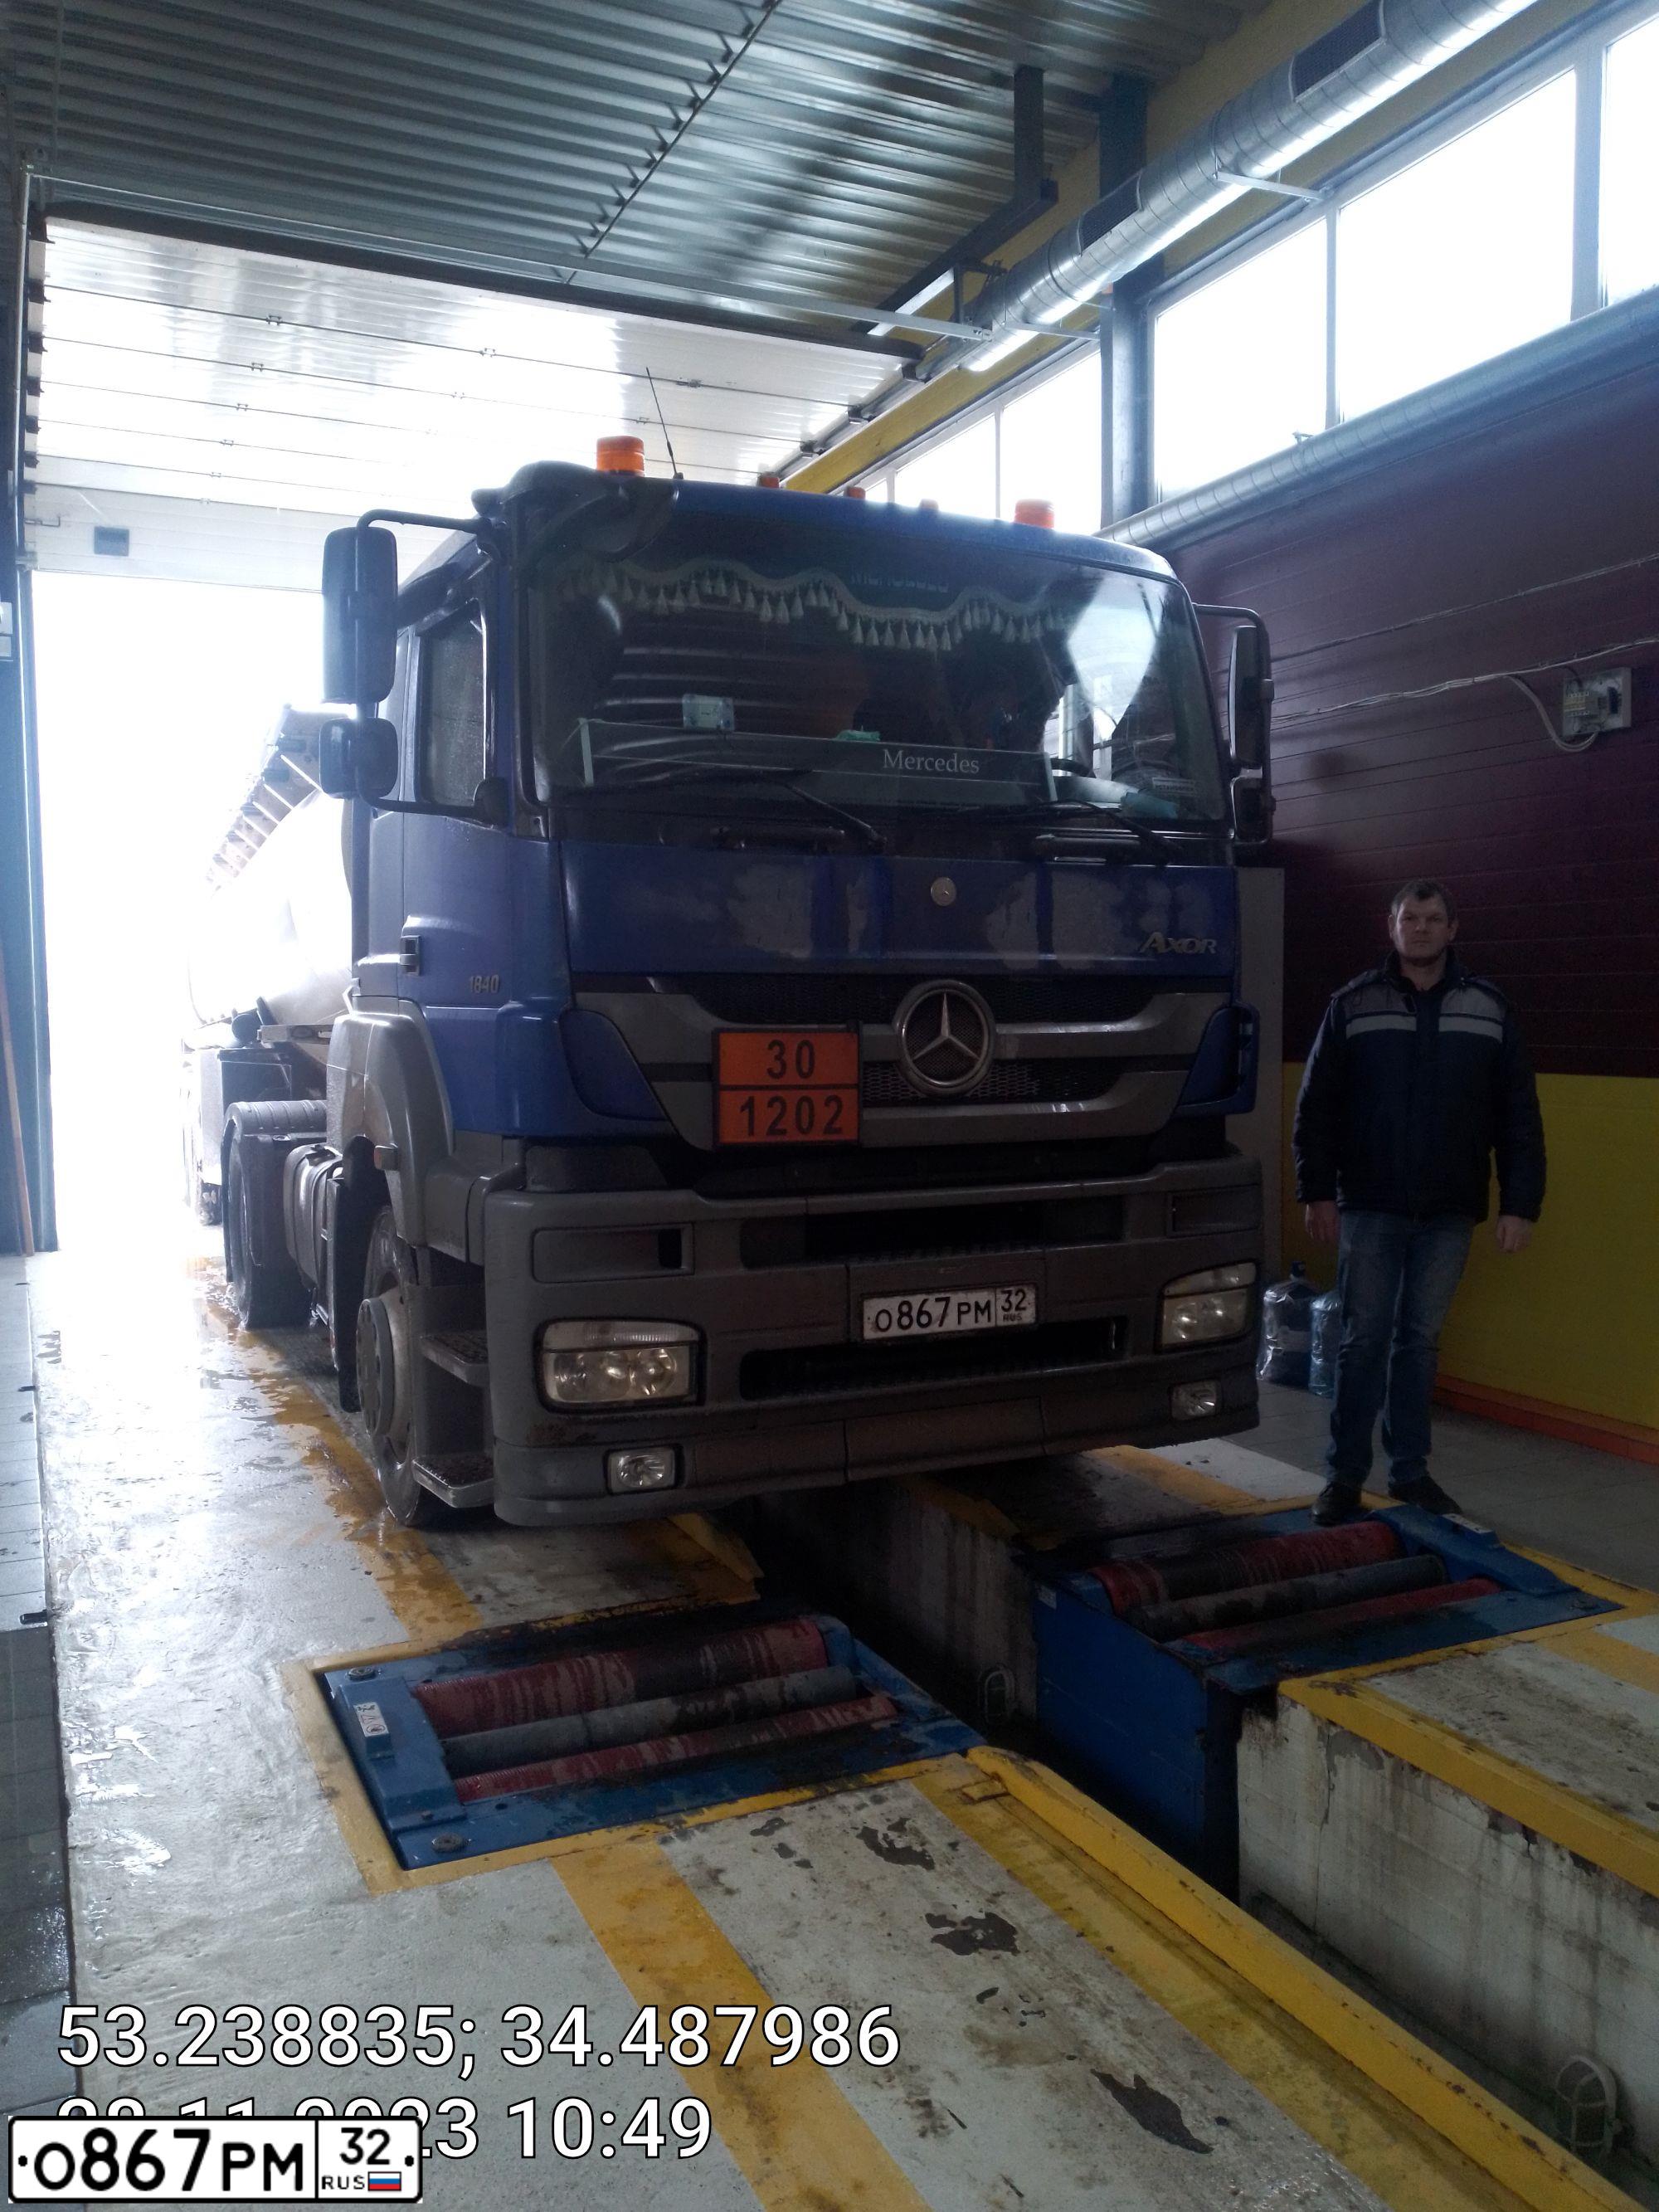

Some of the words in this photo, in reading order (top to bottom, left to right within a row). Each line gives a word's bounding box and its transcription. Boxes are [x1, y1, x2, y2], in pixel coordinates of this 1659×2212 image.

[883, 748, 980, 774] Mercedes
[469, 974, 499, 994] 1840
[766, 1039, 815, 1079] 30
[740, 1094, 844, 1137] 1202
[1000, 1288, 1027, 1312] 32
